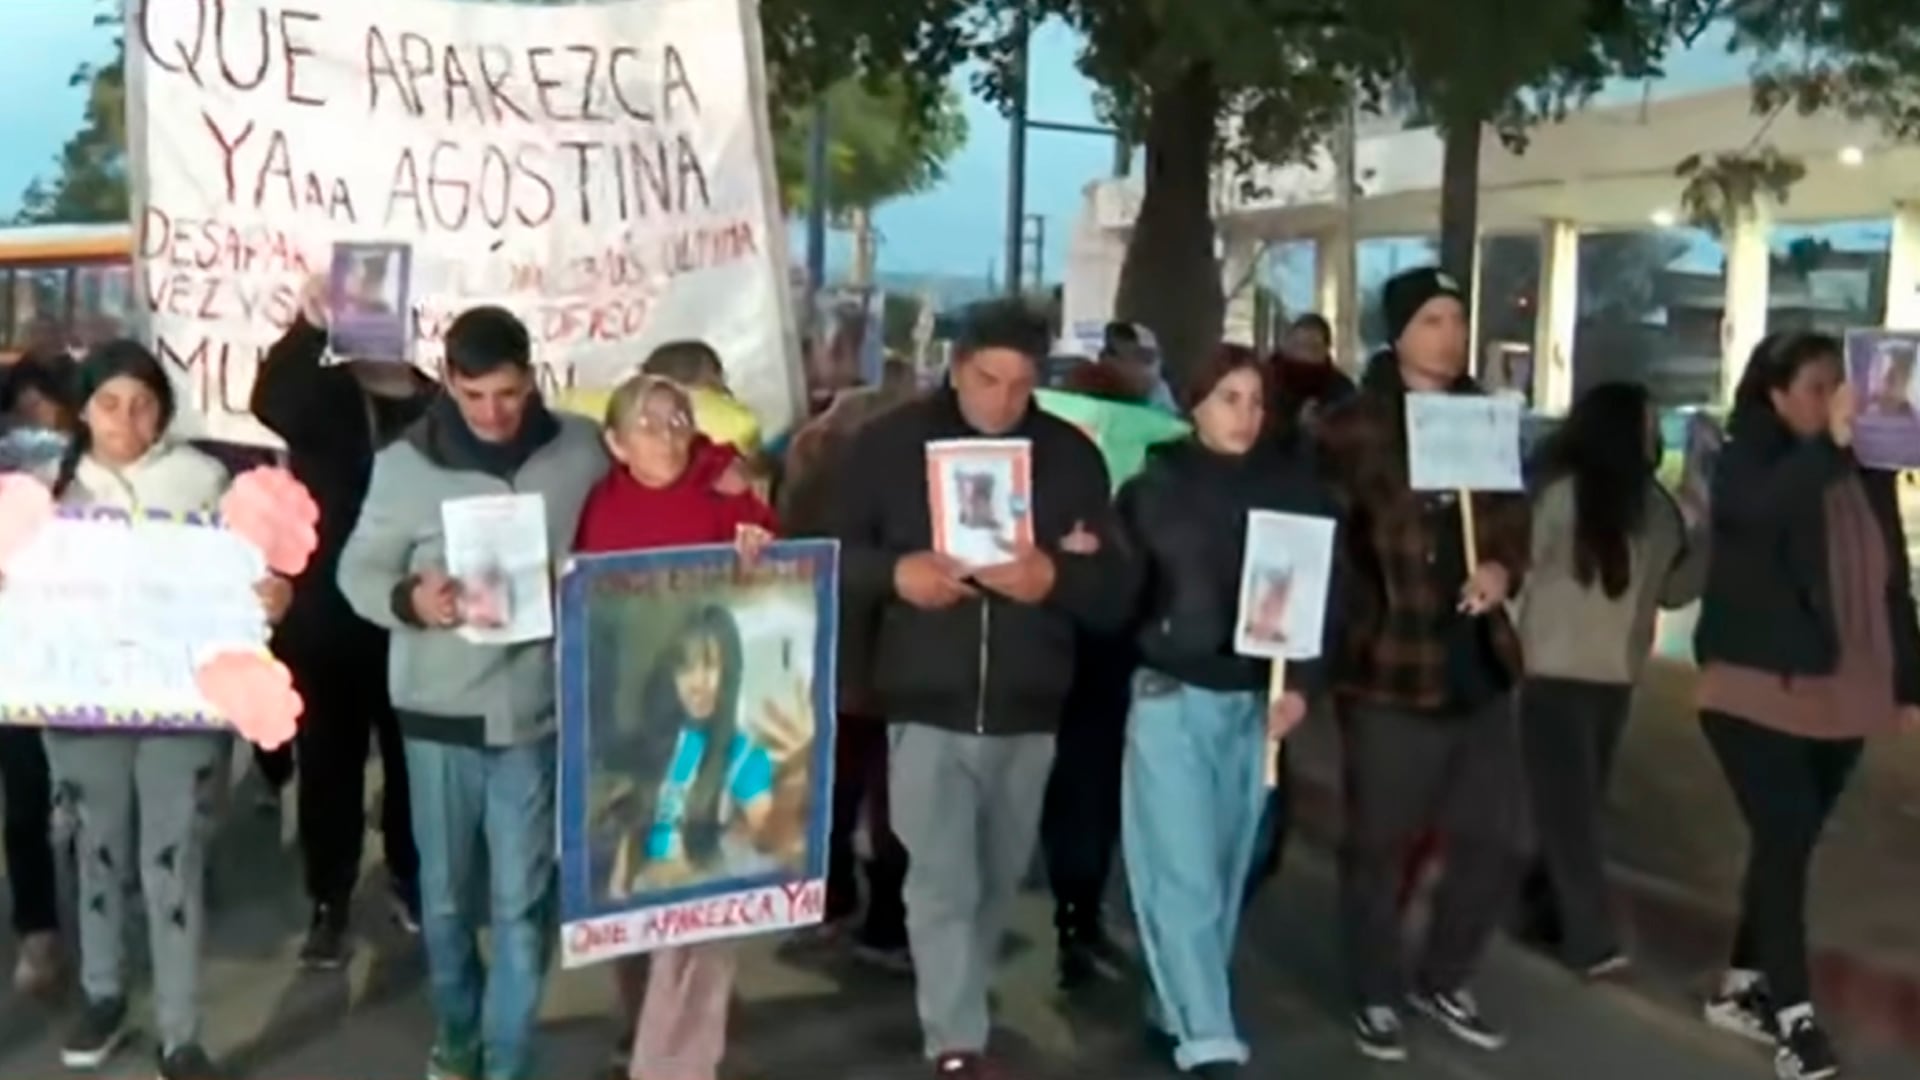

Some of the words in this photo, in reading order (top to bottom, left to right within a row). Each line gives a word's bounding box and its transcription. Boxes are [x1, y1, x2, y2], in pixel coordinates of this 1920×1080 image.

[140, 0, 326, 106] QUE
[365, 25, 701, 125] APAREZCA
[384, 133, 711, 233] AGOSTINA
[143, 268, 225, 320] VEZ
